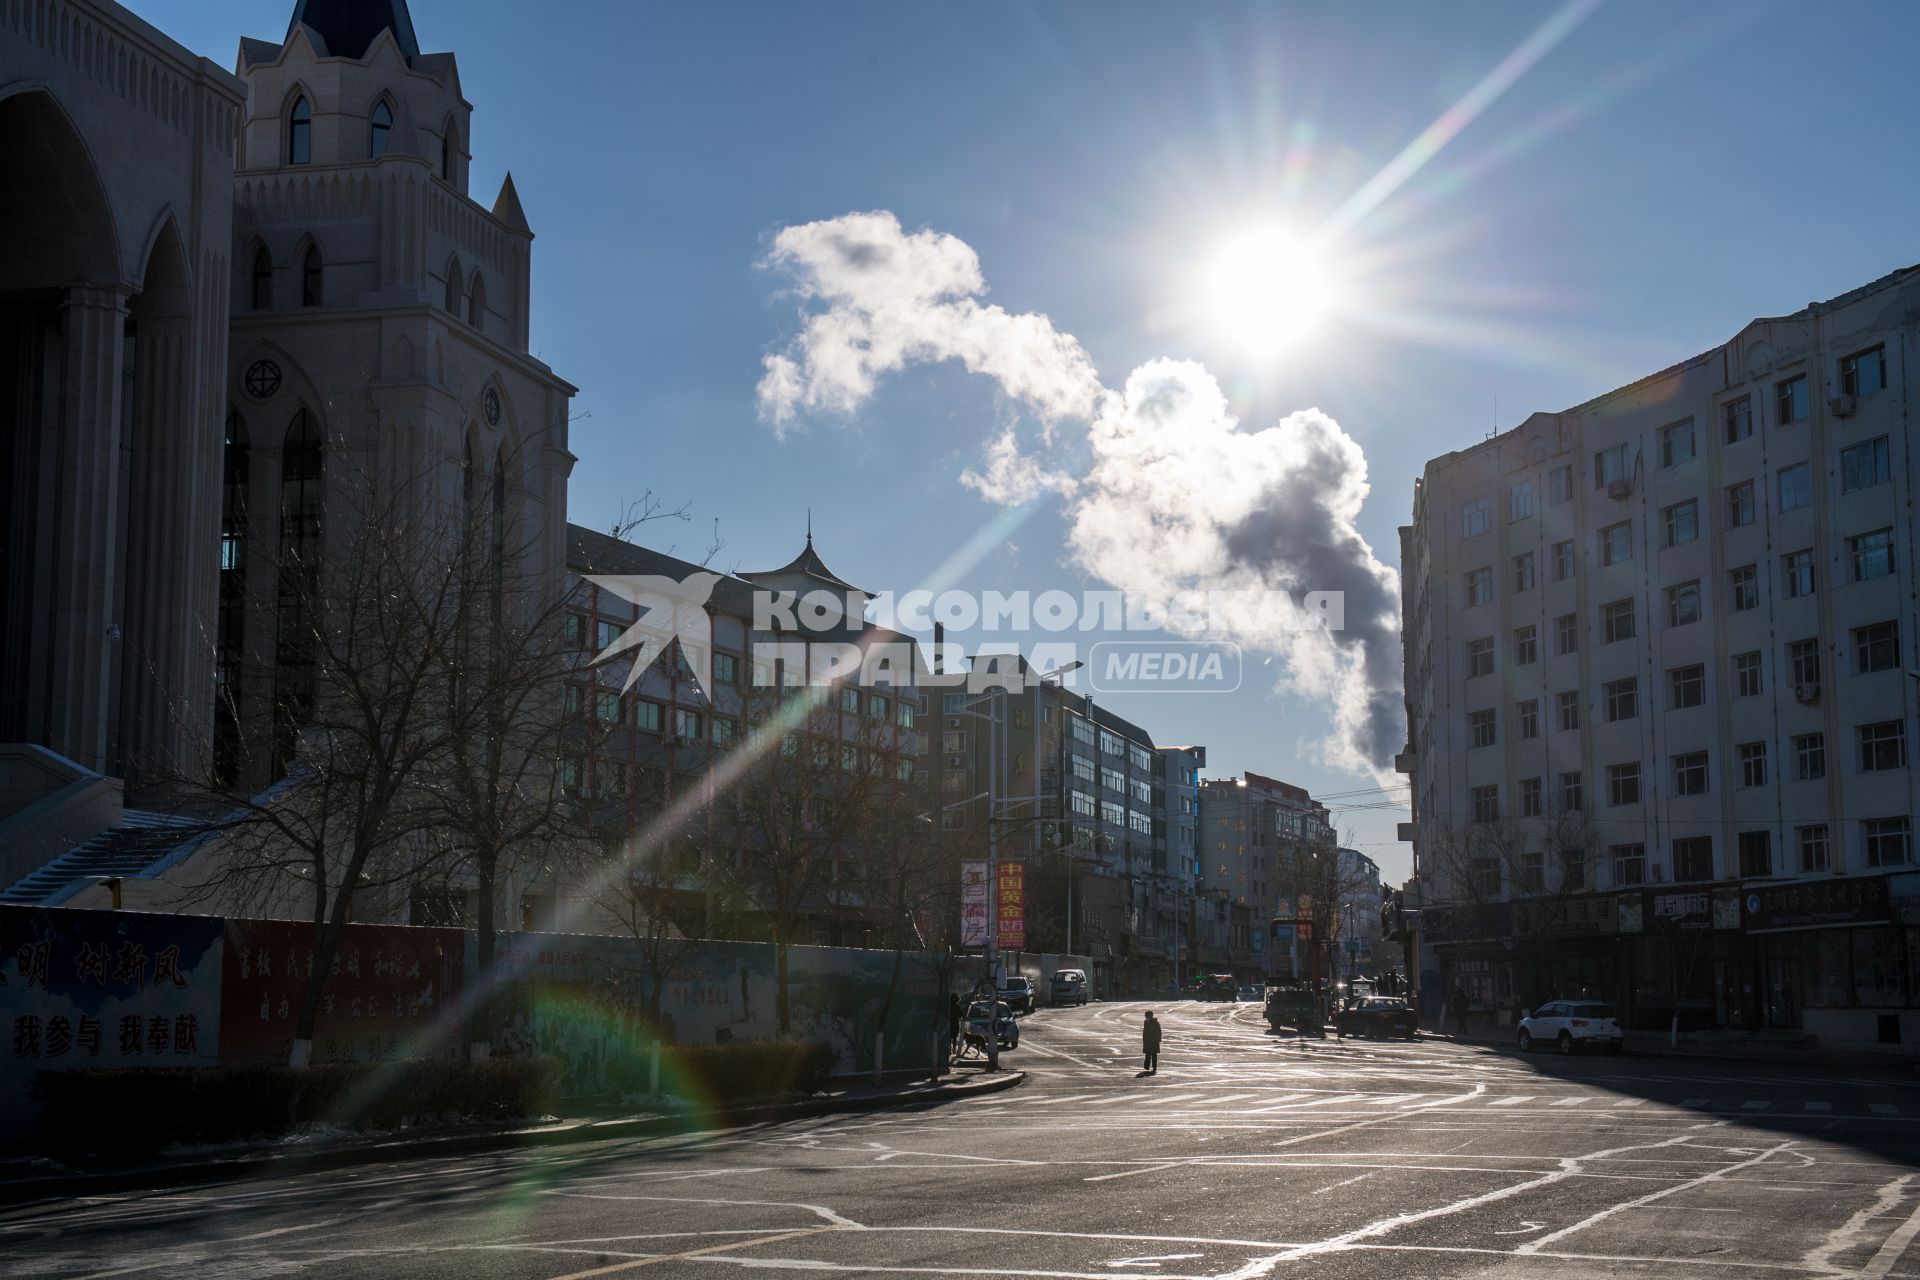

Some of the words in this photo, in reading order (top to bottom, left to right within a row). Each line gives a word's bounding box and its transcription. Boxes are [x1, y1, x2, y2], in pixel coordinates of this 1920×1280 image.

[1000, 863, 1023, 917] 中国黄金
[74, 941, 188, 992] 树新风
[13, 1015, 102, 1058] 我参与
[119, 1014, 199, 1056] 我奉献
